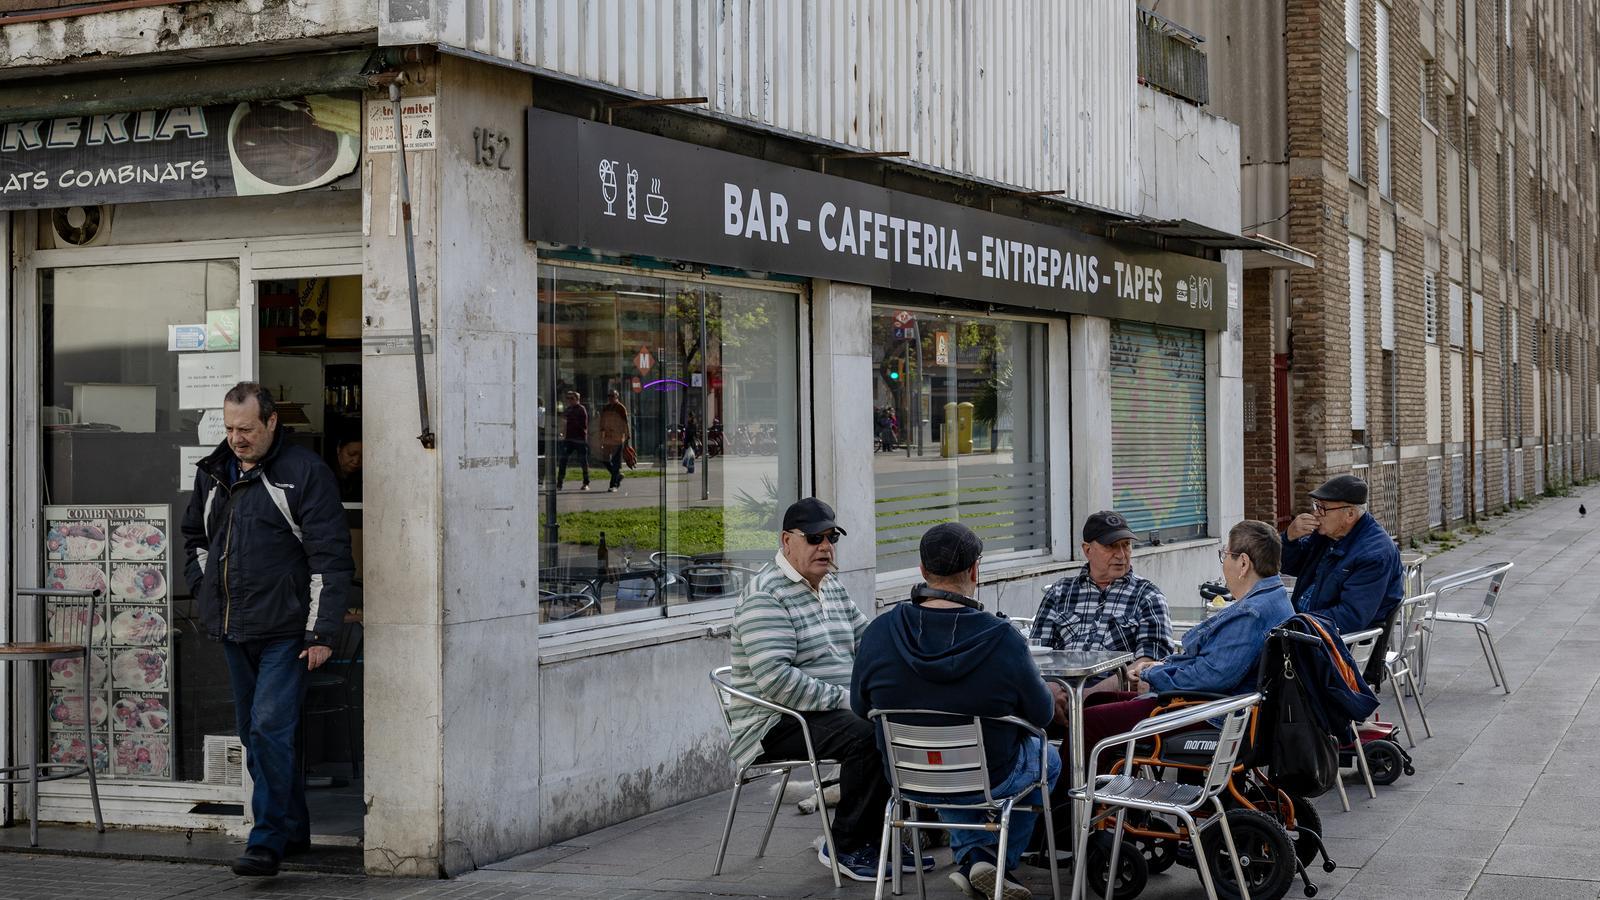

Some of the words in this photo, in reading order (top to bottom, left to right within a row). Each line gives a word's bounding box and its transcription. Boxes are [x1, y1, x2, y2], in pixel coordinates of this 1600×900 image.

[382, 103, 433, 116] trsmitel
[385, 125, 396, 140] 25
[472, 126, 511, 171] 152
[58, 160, 208, 188] COMBINATS
[724, 182, 790, 245] BAR
[818, 201, 963, 273] CAFETERIA
[981, 235, 1099, 294] ENTREPANS
[1114, 261, 1163, 304] TAPES
[67, 508, 145, 519] COMBINADOS
